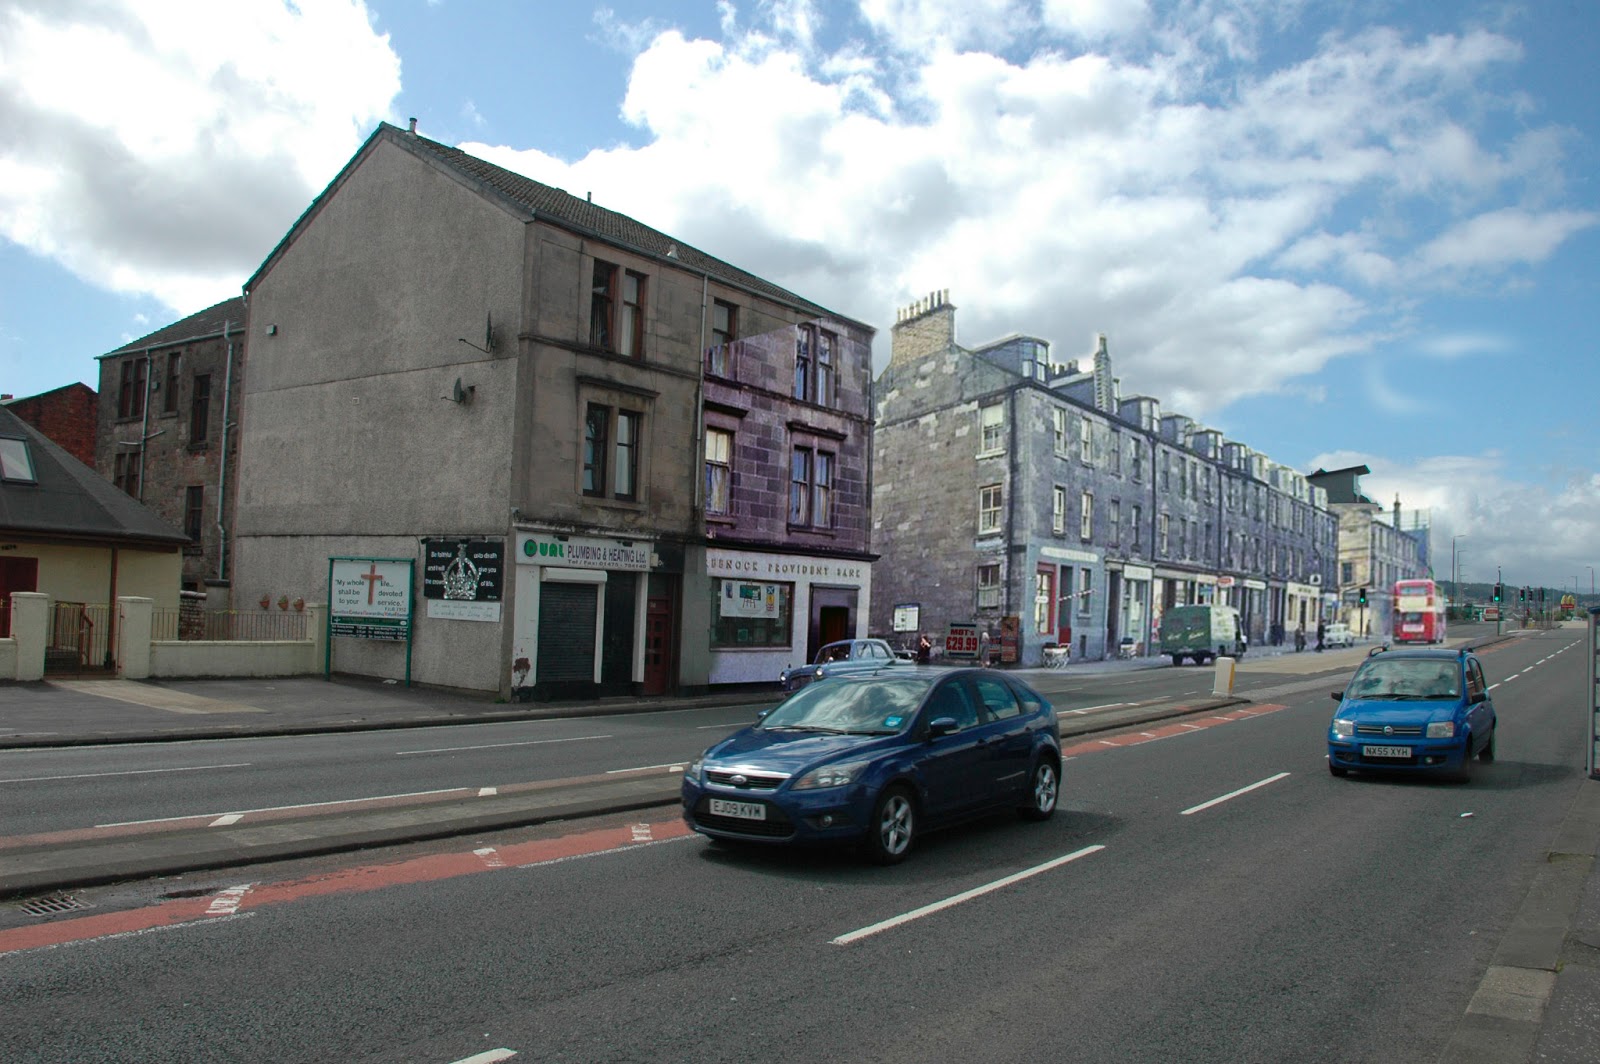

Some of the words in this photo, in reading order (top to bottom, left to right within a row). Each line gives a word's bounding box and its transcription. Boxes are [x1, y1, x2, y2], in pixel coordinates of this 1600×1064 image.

[524, 539, 564, 558] DUAL
[567, 545, 601, 560] PLUMBING
[602, 548, 607, 560] &
[609, 549, 635, 563] HEATING
[768, 563, 829, 576] PROVIDENT
[950, 628, 975, 636] MOT's
[946, 636, 978, 651] £29.99
[1366, 747, 1388, 755] NX55
[1390, 748, 1408, 756] XYH
[714, 800, 738, 814] EJ09
